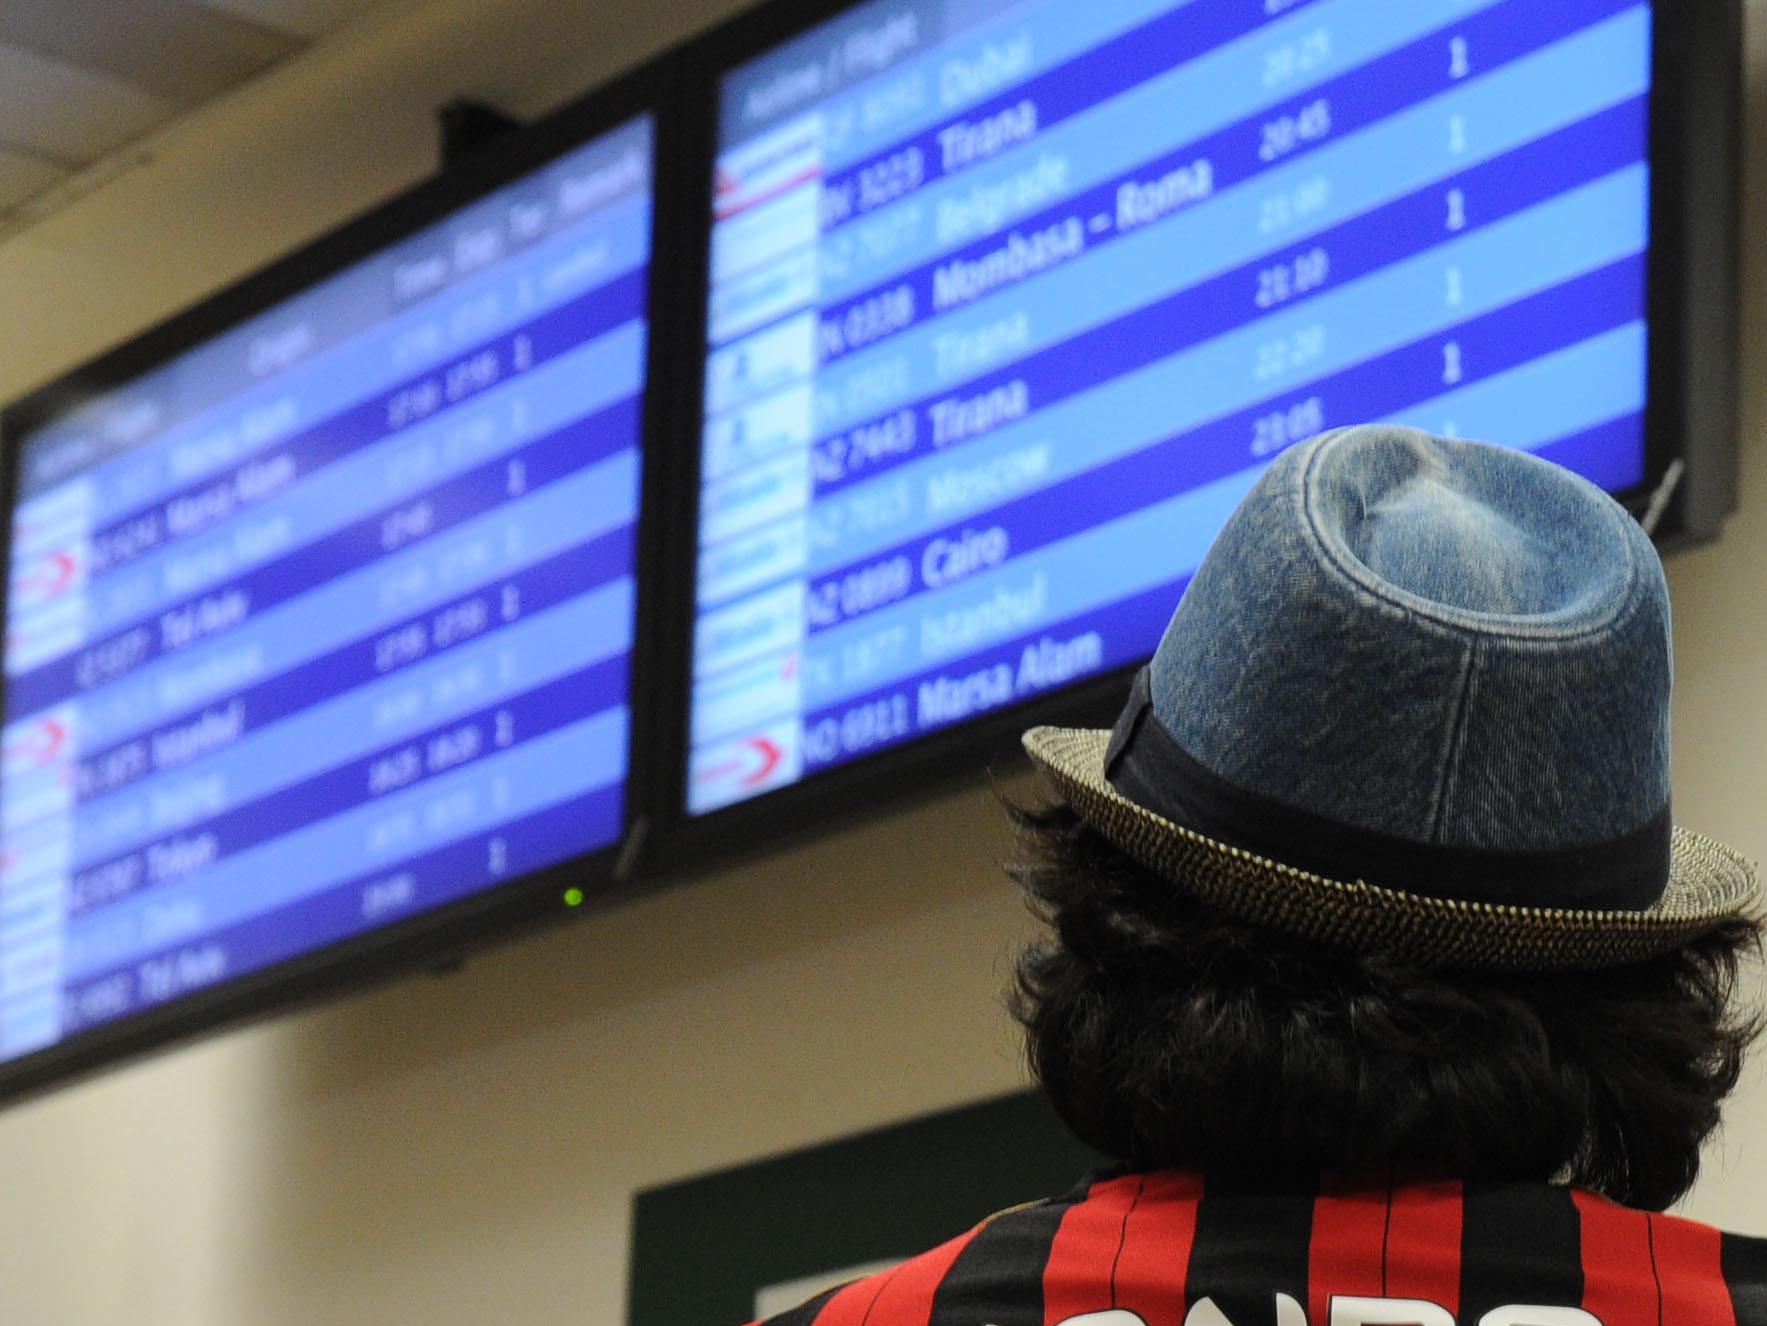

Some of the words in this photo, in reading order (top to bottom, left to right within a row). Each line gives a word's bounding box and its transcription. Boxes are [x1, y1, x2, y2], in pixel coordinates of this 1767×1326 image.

[936, 99, 1039, 173] Tirana
[938, 32, 1032, 102] Dubai
[932, 215, 1085, 311] Mombasa
[1114, 157, 1215, 232] Roma
[1448, 35, 1469, 80] 1
[933, 310, 1031, 379] Tirana
[1448, 113, 1467, 154] 1
[936, 152, 1070, 244] Belgrade
[926, 442, 1052, 512] Moscow
[1444, 265, 1463, 306] 1
[930, 376, 1030, 448] Tirana
[1445, 187, 1466, 232] 1
[920, 525, 1009, 590] Cairo
[1441, 341, 1462, 385] 1
[916, 663, 1014, 729] Marsa
[1015, 630, 1103, 695] Alam
[919, 570, 1048, 656] Istanbul
